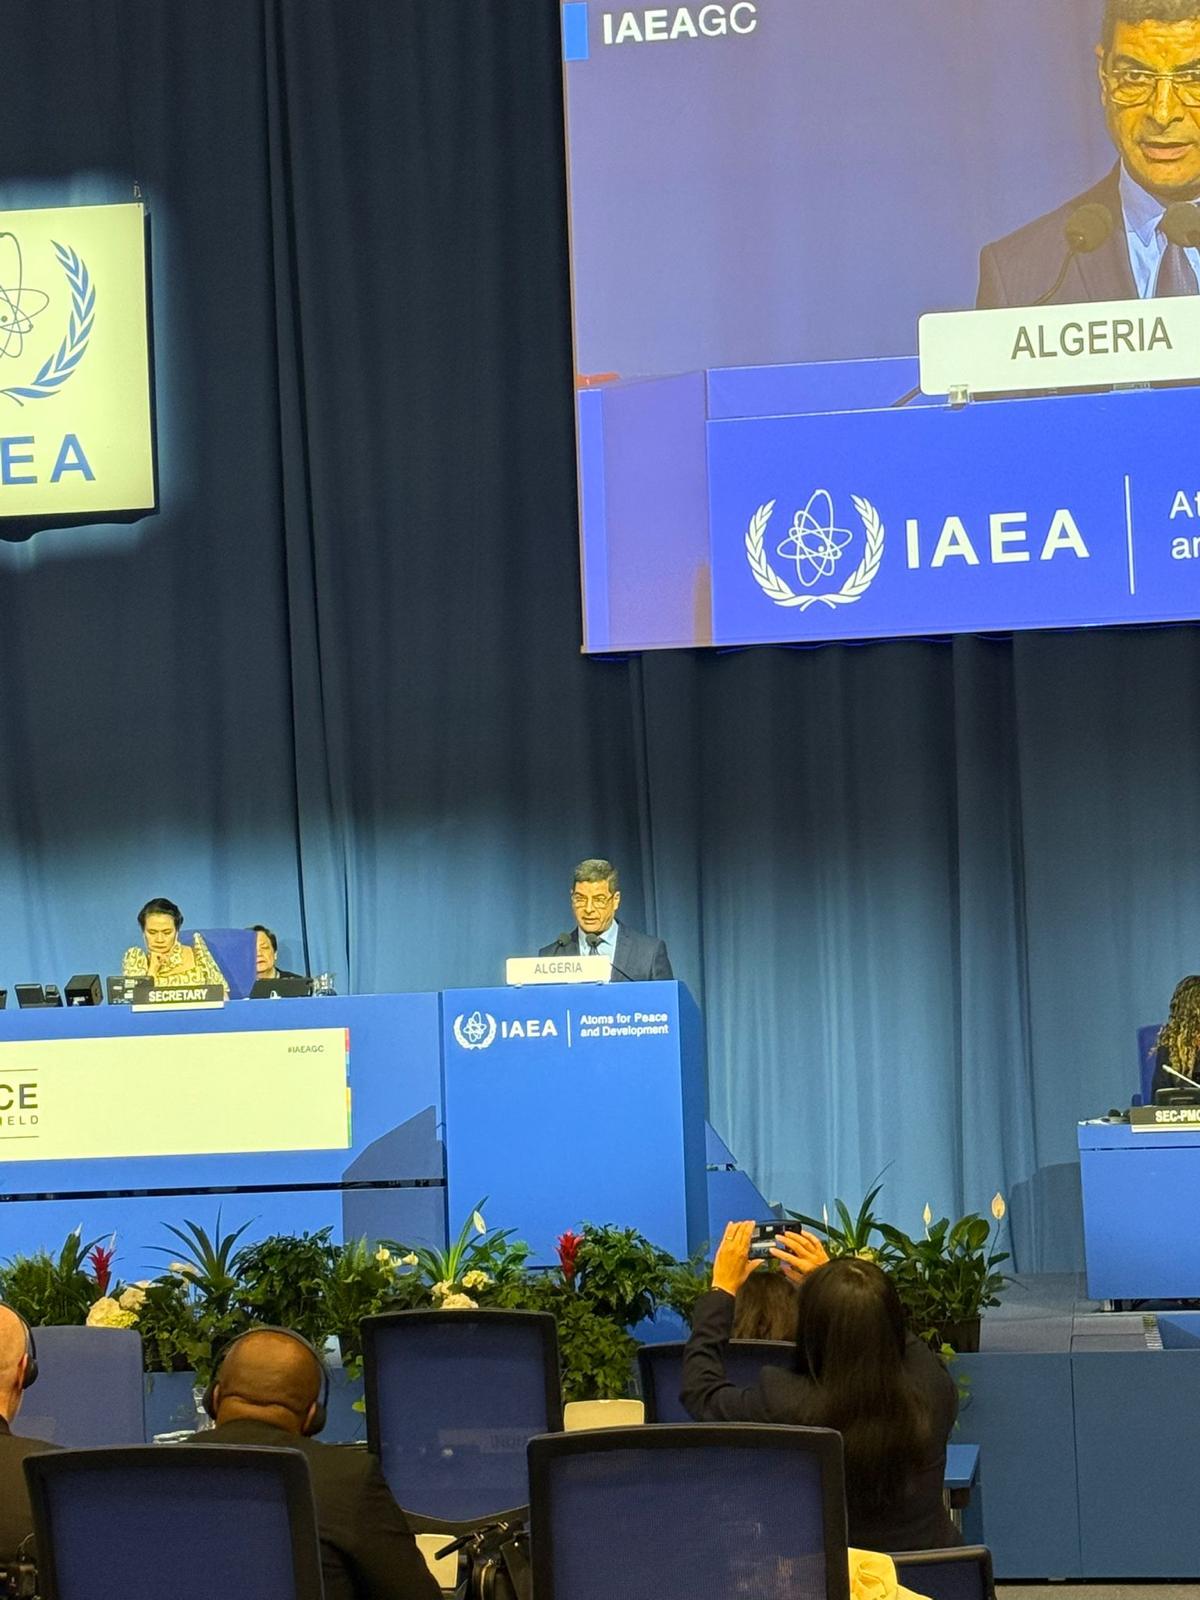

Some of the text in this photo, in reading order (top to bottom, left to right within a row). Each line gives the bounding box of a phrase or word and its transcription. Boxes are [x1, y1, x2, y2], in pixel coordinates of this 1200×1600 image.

[603, 2, 757, 45] IAEAGC
[1010, 316, 1173, 361] ALGERIA
[905, 508, 1091, 570] IAEA
[534, 961, 583, 975] ALGERIA
[148, 988, 208, 1002] SECRETARY
[580, 1012, 668, 1025] Atoms for Peace
[501, 1019, 558, 1039] IAEA
[580, 1024, 669, 1037] and Development
